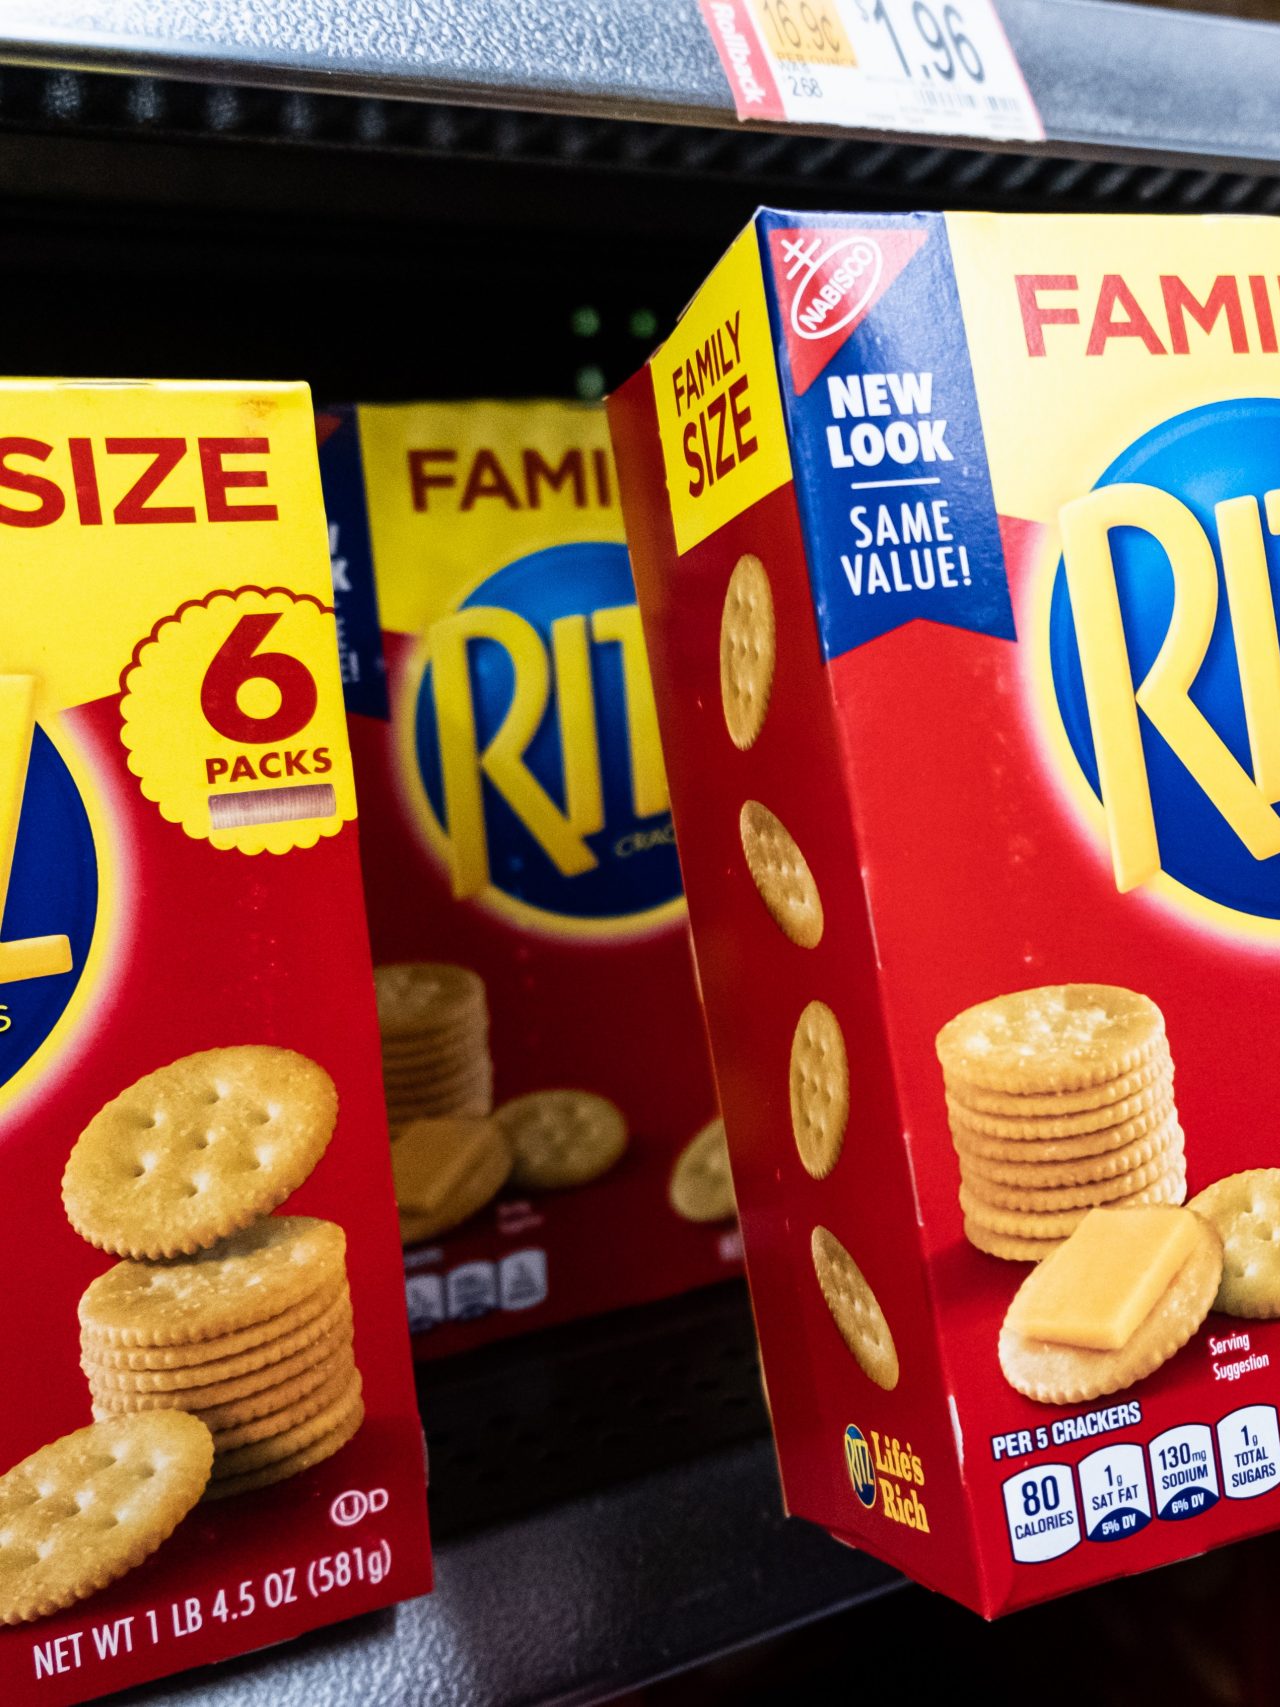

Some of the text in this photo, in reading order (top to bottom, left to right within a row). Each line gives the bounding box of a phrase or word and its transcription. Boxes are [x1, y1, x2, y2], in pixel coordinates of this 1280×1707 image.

[710, 3, 766, 104] Rollback
[800, 245, 874, 331] NABISCO
[672, 310, 742, 418] FAMILY
[826, 372, 934, 420] NEW
[683, 374, 759, 499] SIZE
[826, 420, 954, 469] LOOK
[0, 436, 279, 529] SIZE
[406, 447, 620, 513] FAMI
[849, 501, 954, 549] SAME
[840, 546, 973, 597] VALUE!
[200, 612, 318, 744] 6
[205, 749, 333, 784] PACKS
[429, 604, 672, 901] RIT
[1209, 1332, 1251, 1357] Serving
[1213, 1352, 1270, 1381] Suggestion
[992, 1401, 1142, 1460] PER 5 CRACKERS
[844, 1432, 875, 1493] RITZ
[870, 1430, 926, 1487] Life's
[1161, 1464, 1209, 1491] SODIUM
[1231, 1463, 1277, 1489] SUGARS
[1234, 1446, 1270, 1469] TOTAL
[878, 1477, 931, 1534] Rich
[1020, 1475, 1061, 1517] 80
[1092, 1484, 1139, 1511] SAT FAT
[1171, 1492, 1206, 1516] 6% DV
[1014, 1510, 1075, 1541] CALORIES
[1101, 1513, 1137, 1537] 5% DV
[33, 1539, 392, 1680] NET WT 1 LB 4.5 OZ (581g)
